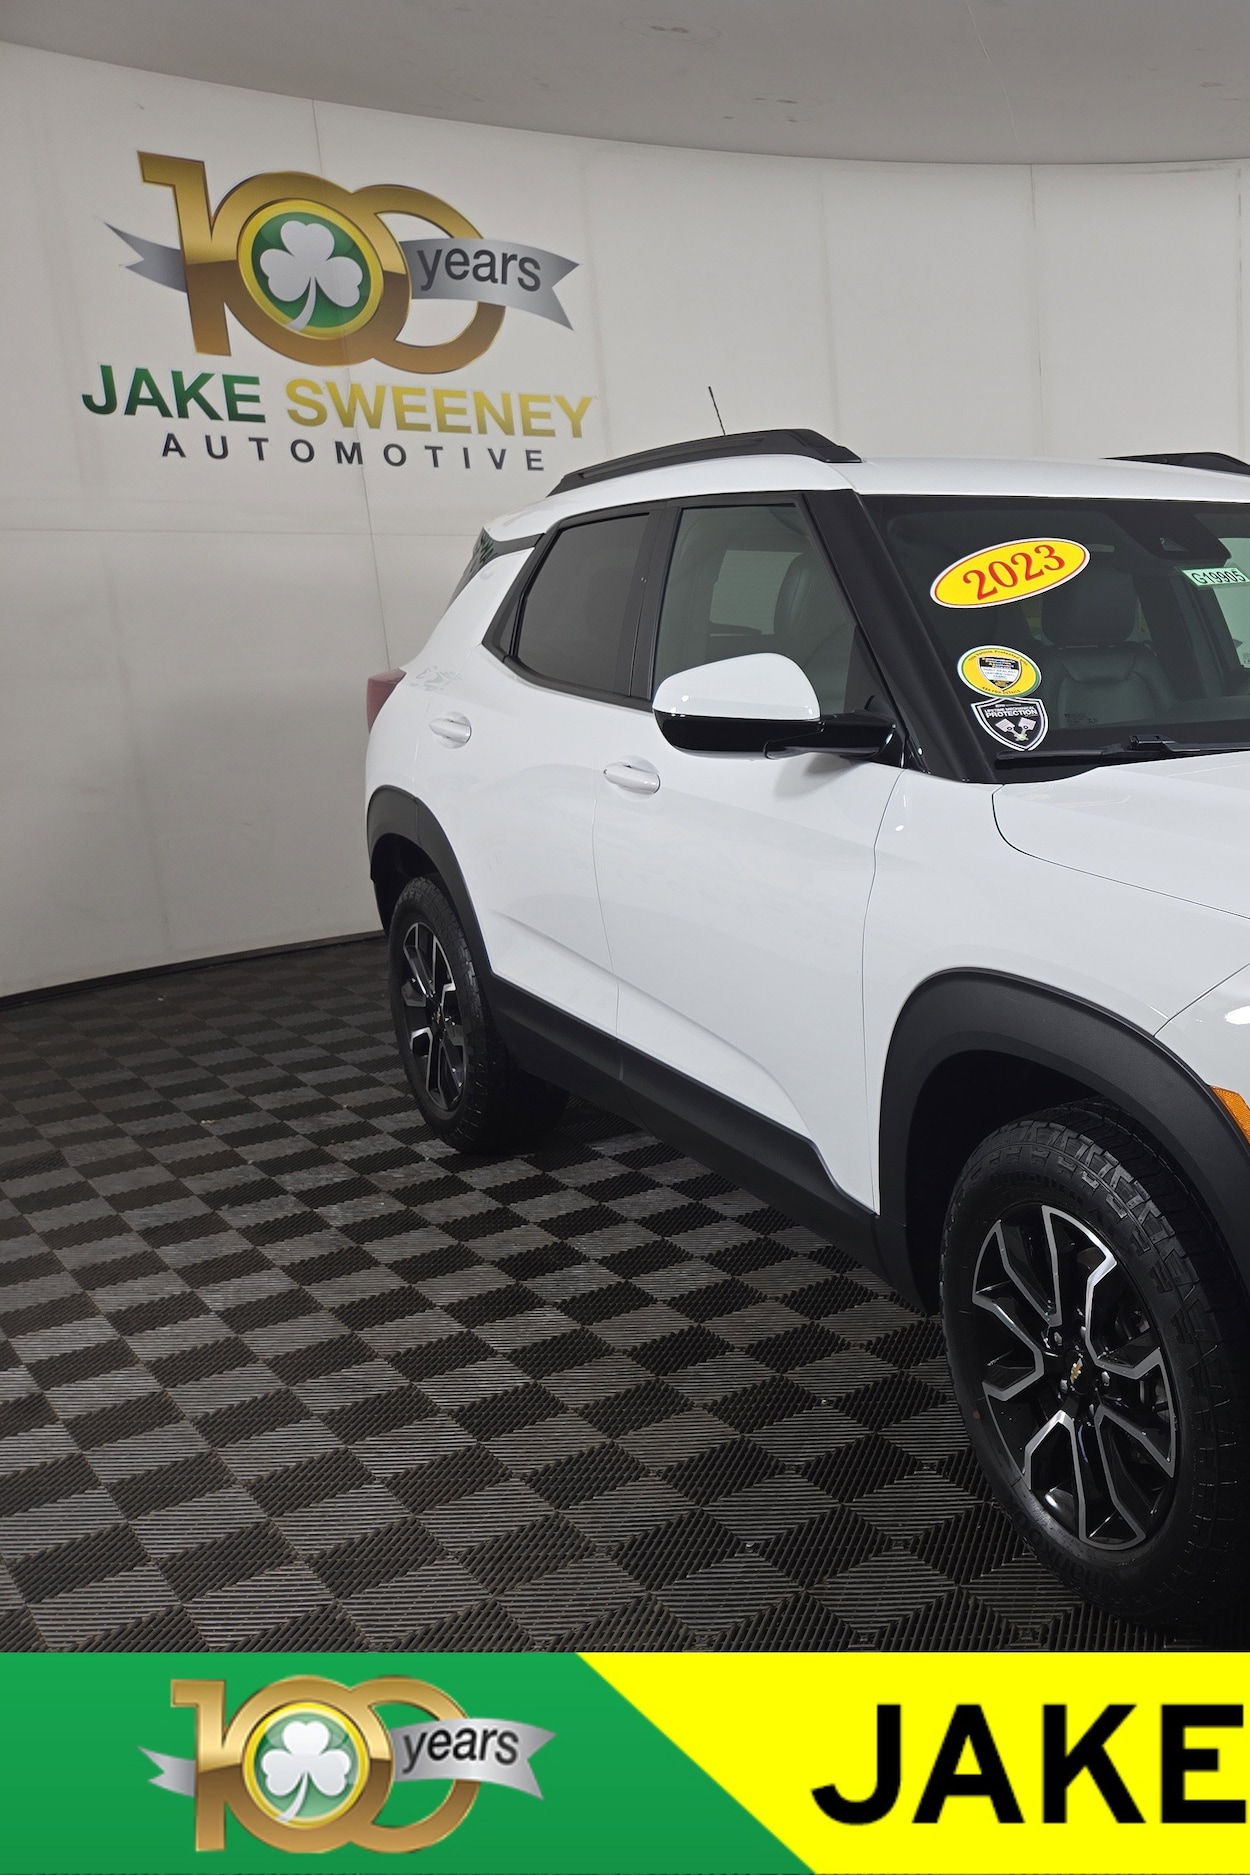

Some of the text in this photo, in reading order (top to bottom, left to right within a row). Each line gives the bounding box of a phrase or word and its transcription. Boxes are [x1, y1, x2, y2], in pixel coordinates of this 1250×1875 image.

[137, 151, 542, 374] 100 years
[81, 364, 594, 438] JAKE SWEENEY
[162, 432, 545, 471] AUTOMOTIVE
[962, 544, 1066, 601] 2023
[1191, 570, 1247, 584] G19905
[986, 710, 1038, 718] PROTECTION
